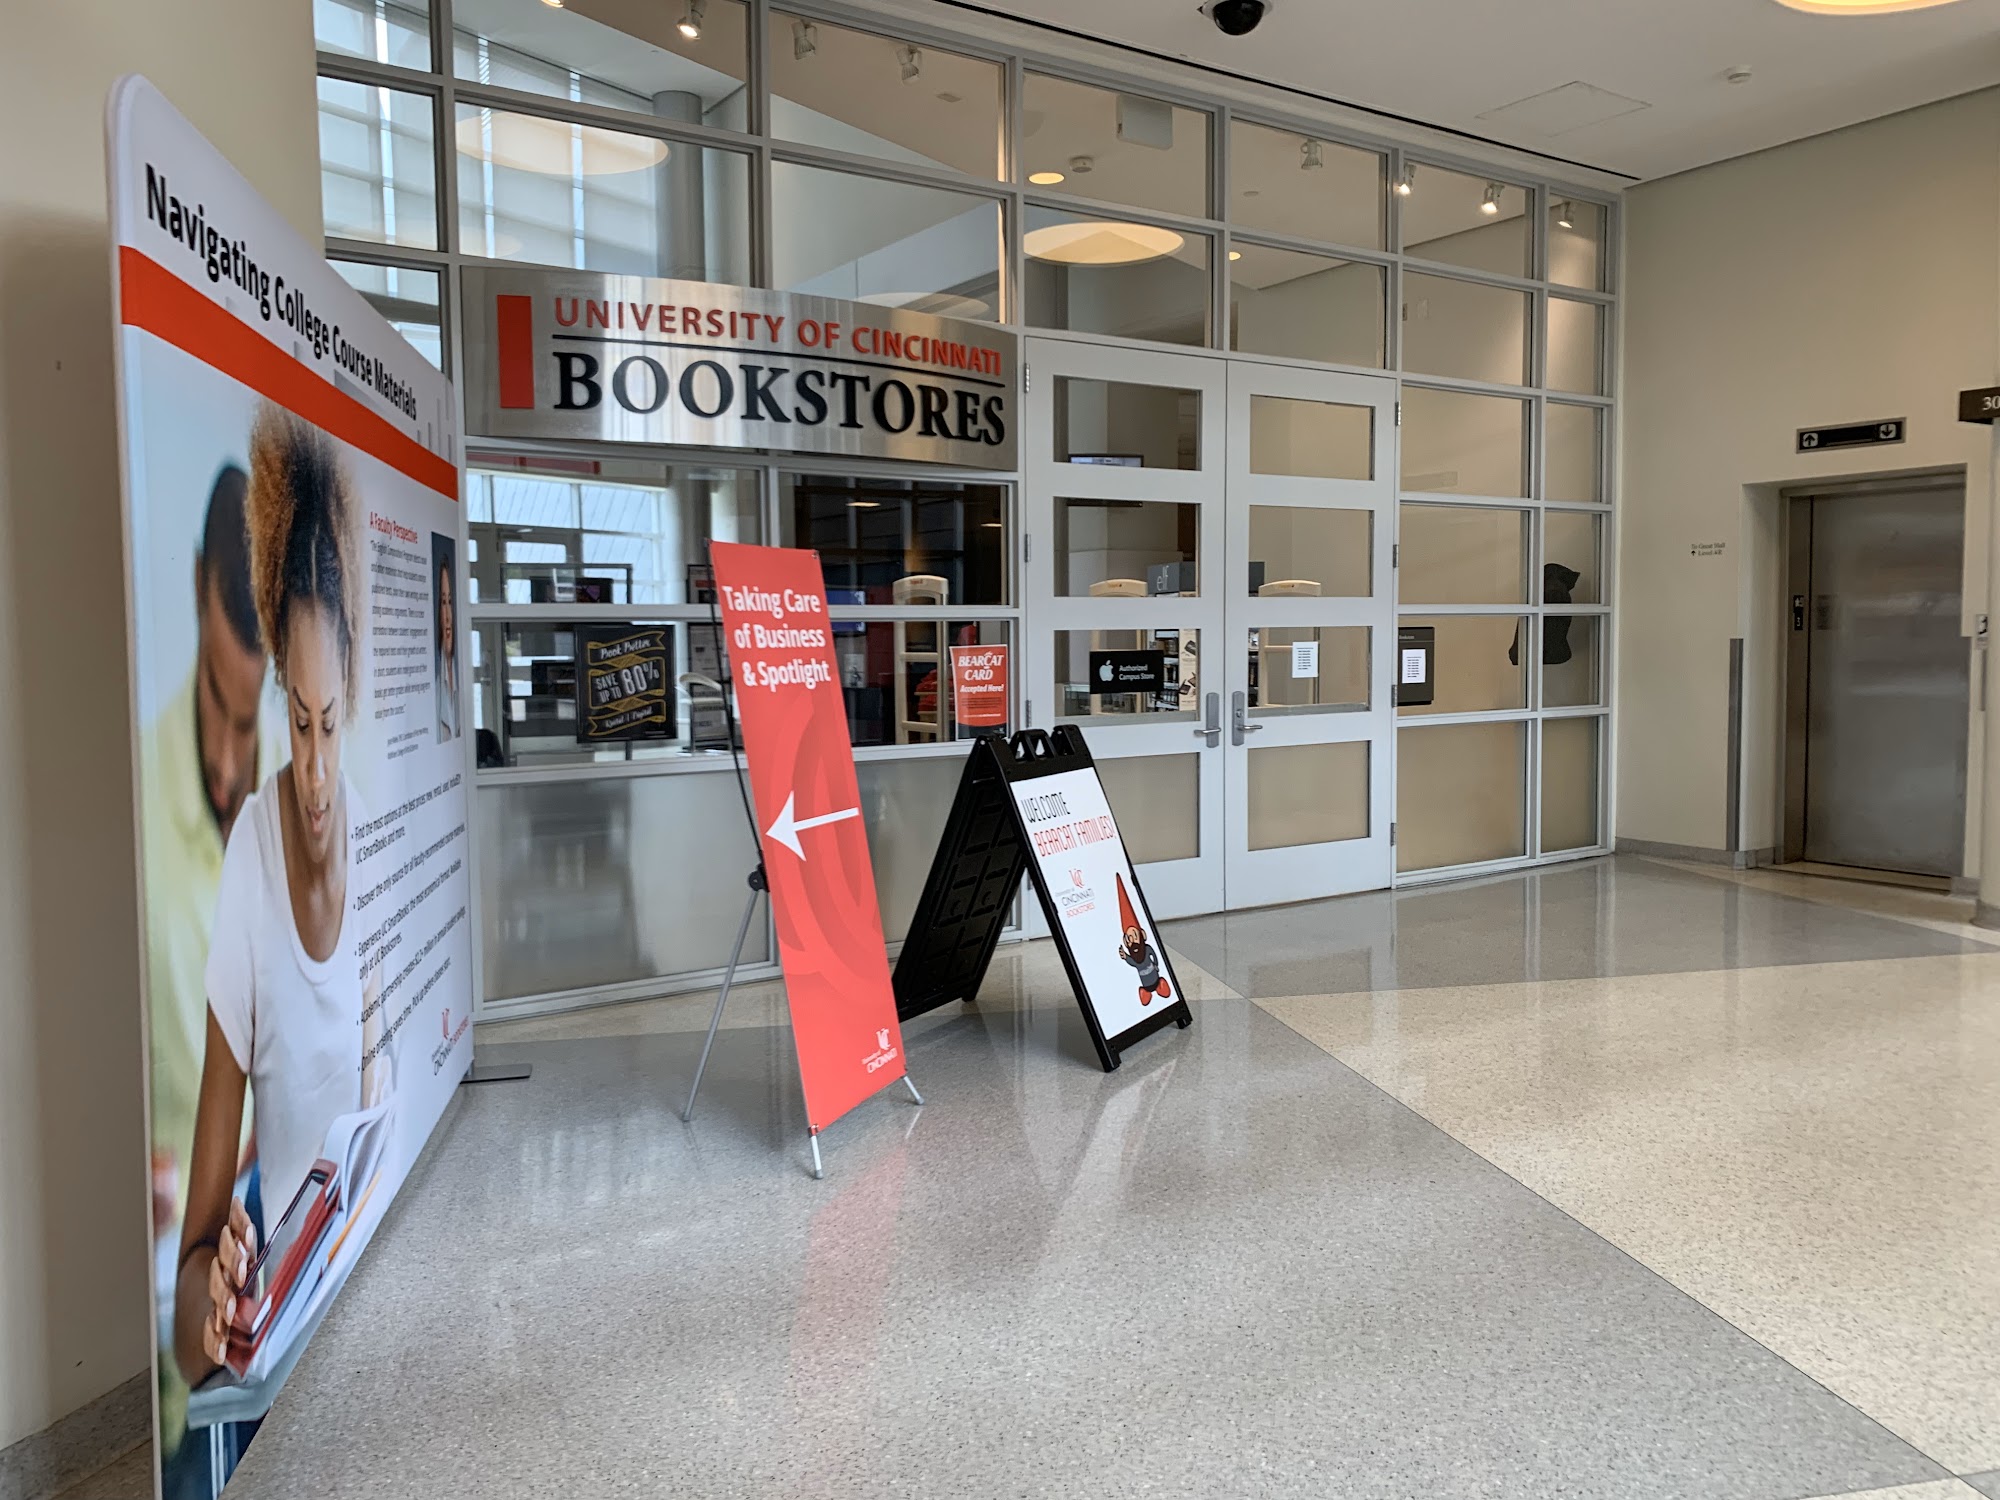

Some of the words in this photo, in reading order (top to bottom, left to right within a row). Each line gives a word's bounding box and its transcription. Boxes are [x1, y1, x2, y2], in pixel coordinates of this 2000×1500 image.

[146, 163, 270, 321] Navigating
[276, 276, 329, 360] College
[333, 325, 372, 386] Course
[374, 358, 416, 420] Materials
[555, 298, 785, 343] UNIVERSITY
[798, 319, 840, 348] OF
[852, 326, 1002, 376] CINCINNATI
[552, 351, 1005, 446] BOOKSTORES
[375, 513, 392, 540] Faculty
[722, 585, 784, 619] Taking
[783, 588, 821, 613] Care
[734, 622, 752, 649] of
[753, 623, 826, 649] Business
[742, 661, 758, 687] &
[757, 658, 831, 692] Spotlight
[958, 652, 1004, 669] BEARCAT
[964, 669, 994, 681] CARD
[1119, 664, 1148, 672] Authorized
[596, 673, 619, 691] SAVE
[622, 661, 660, 694] 80%
[960, 685, 988, 694] Accepted
[988, 684, 1004, 692] Here!
[1119, 673, 1140, 681] Campus
[1140, 672, 1155, 680] Store
[600, 689, 611, 703] UP
[611, 686, 622, 699] TO
[1020, 792, 1070, 823] WELCOME
[1034, 824, 1077, 857] BEARCAT
